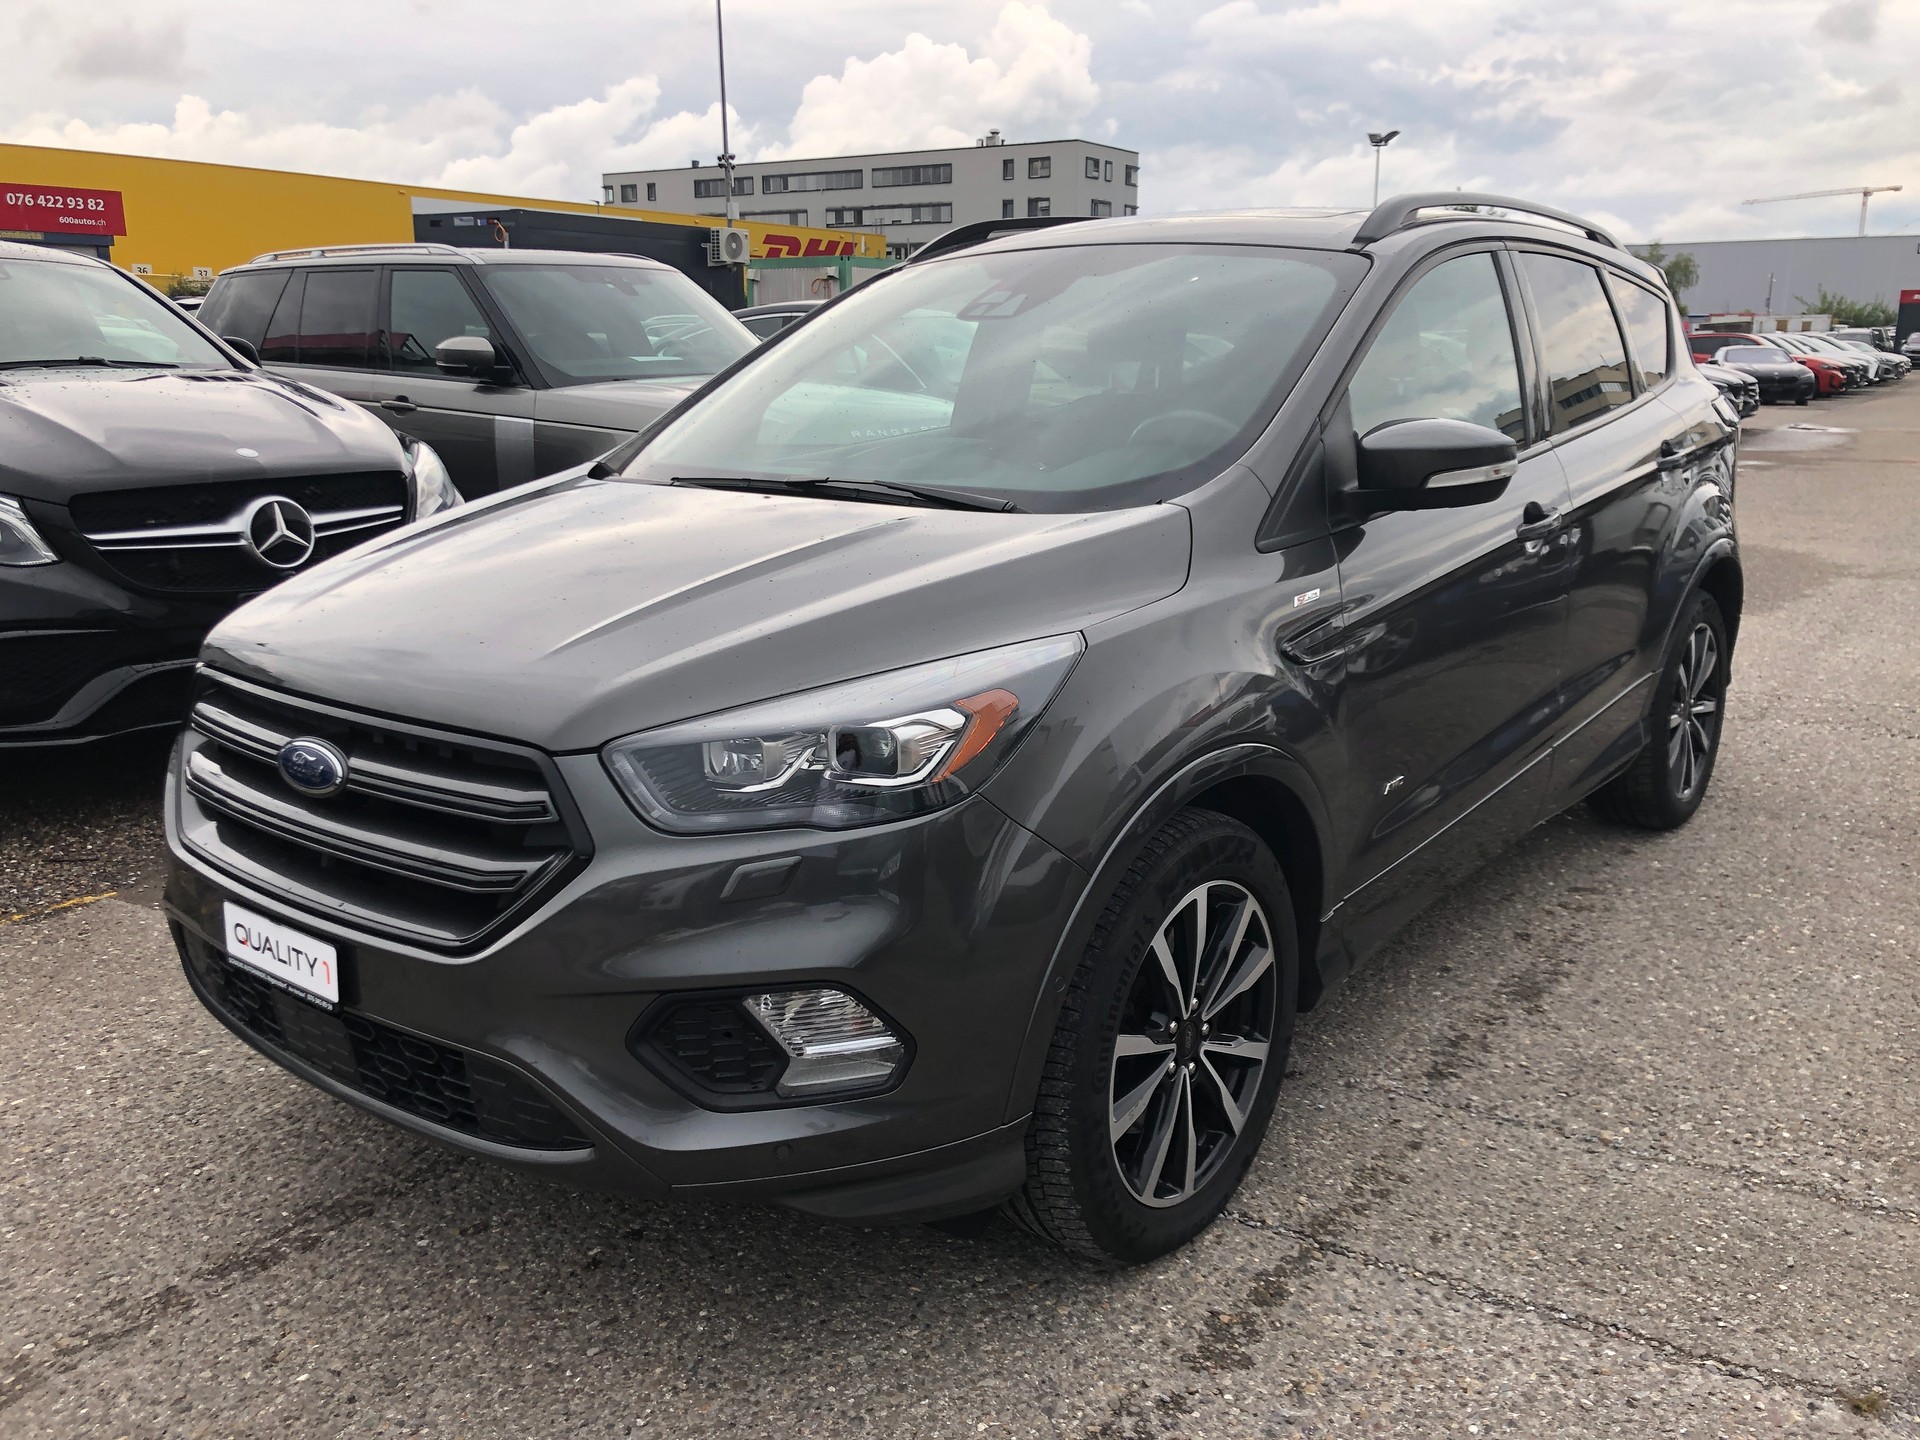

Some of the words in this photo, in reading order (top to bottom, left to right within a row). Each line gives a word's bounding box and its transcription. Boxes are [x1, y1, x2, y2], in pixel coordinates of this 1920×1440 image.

[6, 192, 34, 206] 076
[37, 194, 64, 209] 422
[66, 197, 84, 210] 93
[87, 198, 105, 211] 82
[59, 216, 106, 226] 600autos.ch
[850, 427, 911, 438] RANGE
[234, 922, 318, 977] QUALITY
[322, 960, 330, 985] 1
[1090, 928, 1146, 1096] Continental
